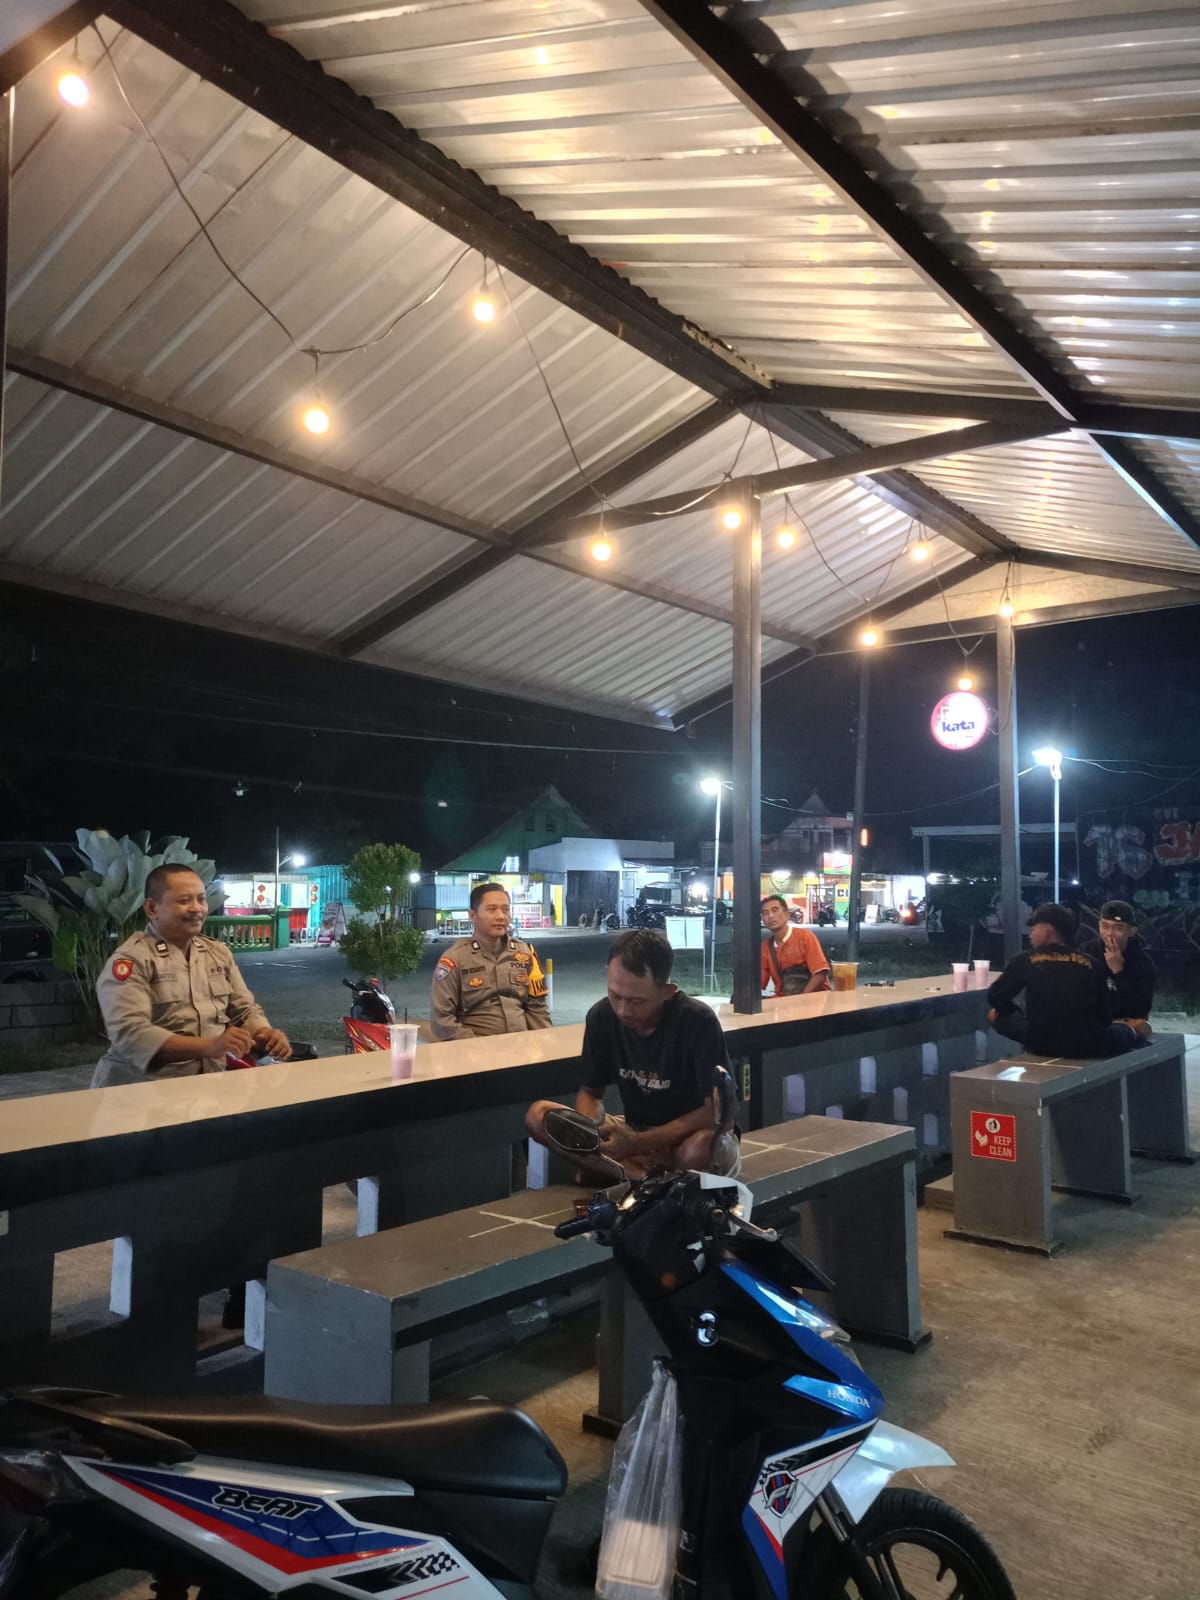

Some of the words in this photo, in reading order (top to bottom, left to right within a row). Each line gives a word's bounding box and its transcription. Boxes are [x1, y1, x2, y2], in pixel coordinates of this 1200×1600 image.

[942, 720, 975, 732] kata
[994, 1135, 1012, 1146] KEEP
[990, 1145, 1012, 1157] CLEAN
[827, 1388, 871, 1409] HONDA
